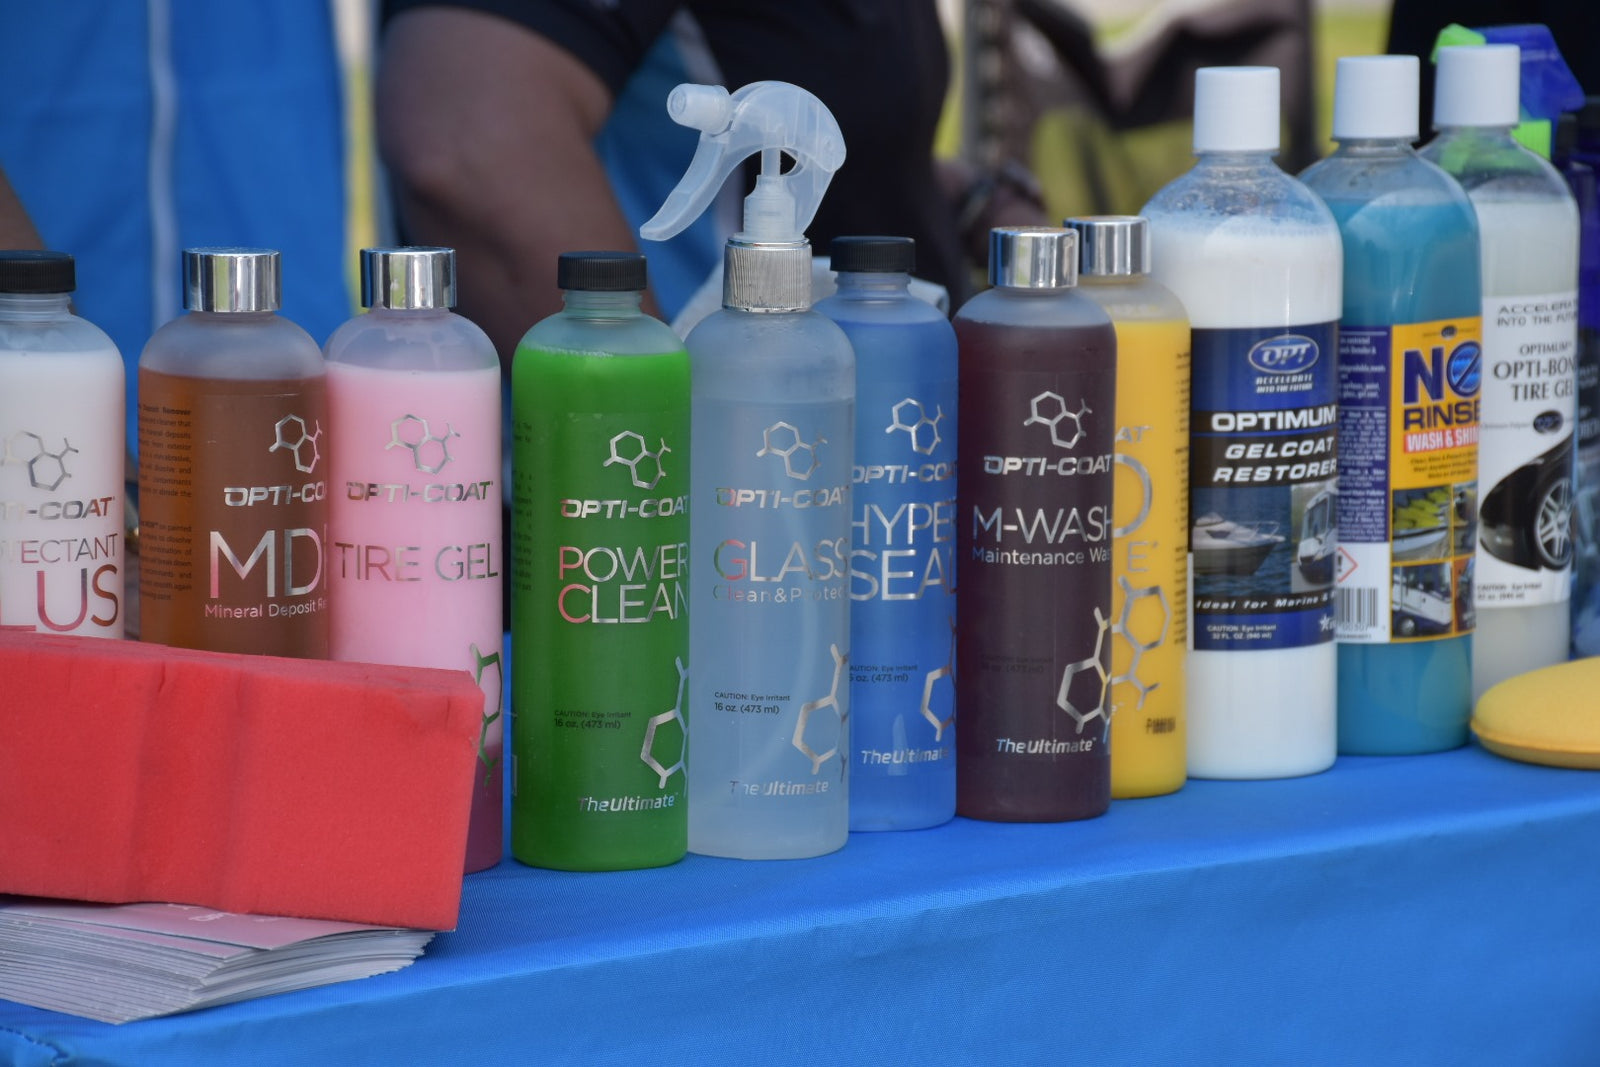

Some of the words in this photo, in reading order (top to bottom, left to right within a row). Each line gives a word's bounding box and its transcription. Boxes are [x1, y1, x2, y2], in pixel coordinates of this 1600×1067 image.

[1497, 317, 1526, 327] INTO
[1532, 315, 1552, 325] THE
[1260, 343, 1311, 366] OPT
[1519, 341, 1570, 357] OPTIMUM
[1403, 341, 1482, 404] NO
[1511, 381, 1550, 402] TIRE
[1211, 405, 1336, 432] OPTIMUM
[1225, 436, 1334, 459] GELCOAT
[1407, 430, 1444, 453] WASH
[1445, 429, 1454, 447] &
[983, 454, 1112, 476] OPTI-COAT
[1212, 458, 1337, 482] RESTORER
[224, 481, 326, 507] OPTI-CO
[346, 480, 493, 503] OPTI-COAT
[973, 505, 1112, 544] M-WASH
[209, 524, 327, 599] MD
[334, 541, 422, 582] TIRE
[434, 542, 499, 582] GEL
[558, 542, 689, 583] POWER
[714, 537, 849, 582] GLASS
[972, 547, 1085, 565] Maintenance
[1089, 547, 1112, 563] Wa
[204, 604, 263, 619] Mineral
[268, 599, 316, 617] Deposit
[558, 580, 689, 624] CLEAN
[1196, 600, 1236, 610] Ideal
[1243, 600, 1268, 610] for
[1275, 596, 1319, 609] Marine
[872, 674, 893, 683] (473
[894, 673, 908, 683] ml)
[714, 692, 748, 701] CAUTION:
[750, 694, 764, 702] Eye
[766, 694, 790, 702] Irritant
[714, 702, 723, 711] 16
[740, 704, 762, 714] (473
[764, 705, 780, 715] ml)
[554, 710, 588, 718] CAUTION:
[591, 711, 605, 719] Eye
[554, 719, 563, 728] 16
[581, 719, 602, 729] (473
[604, 720, 621, 729] ml)
